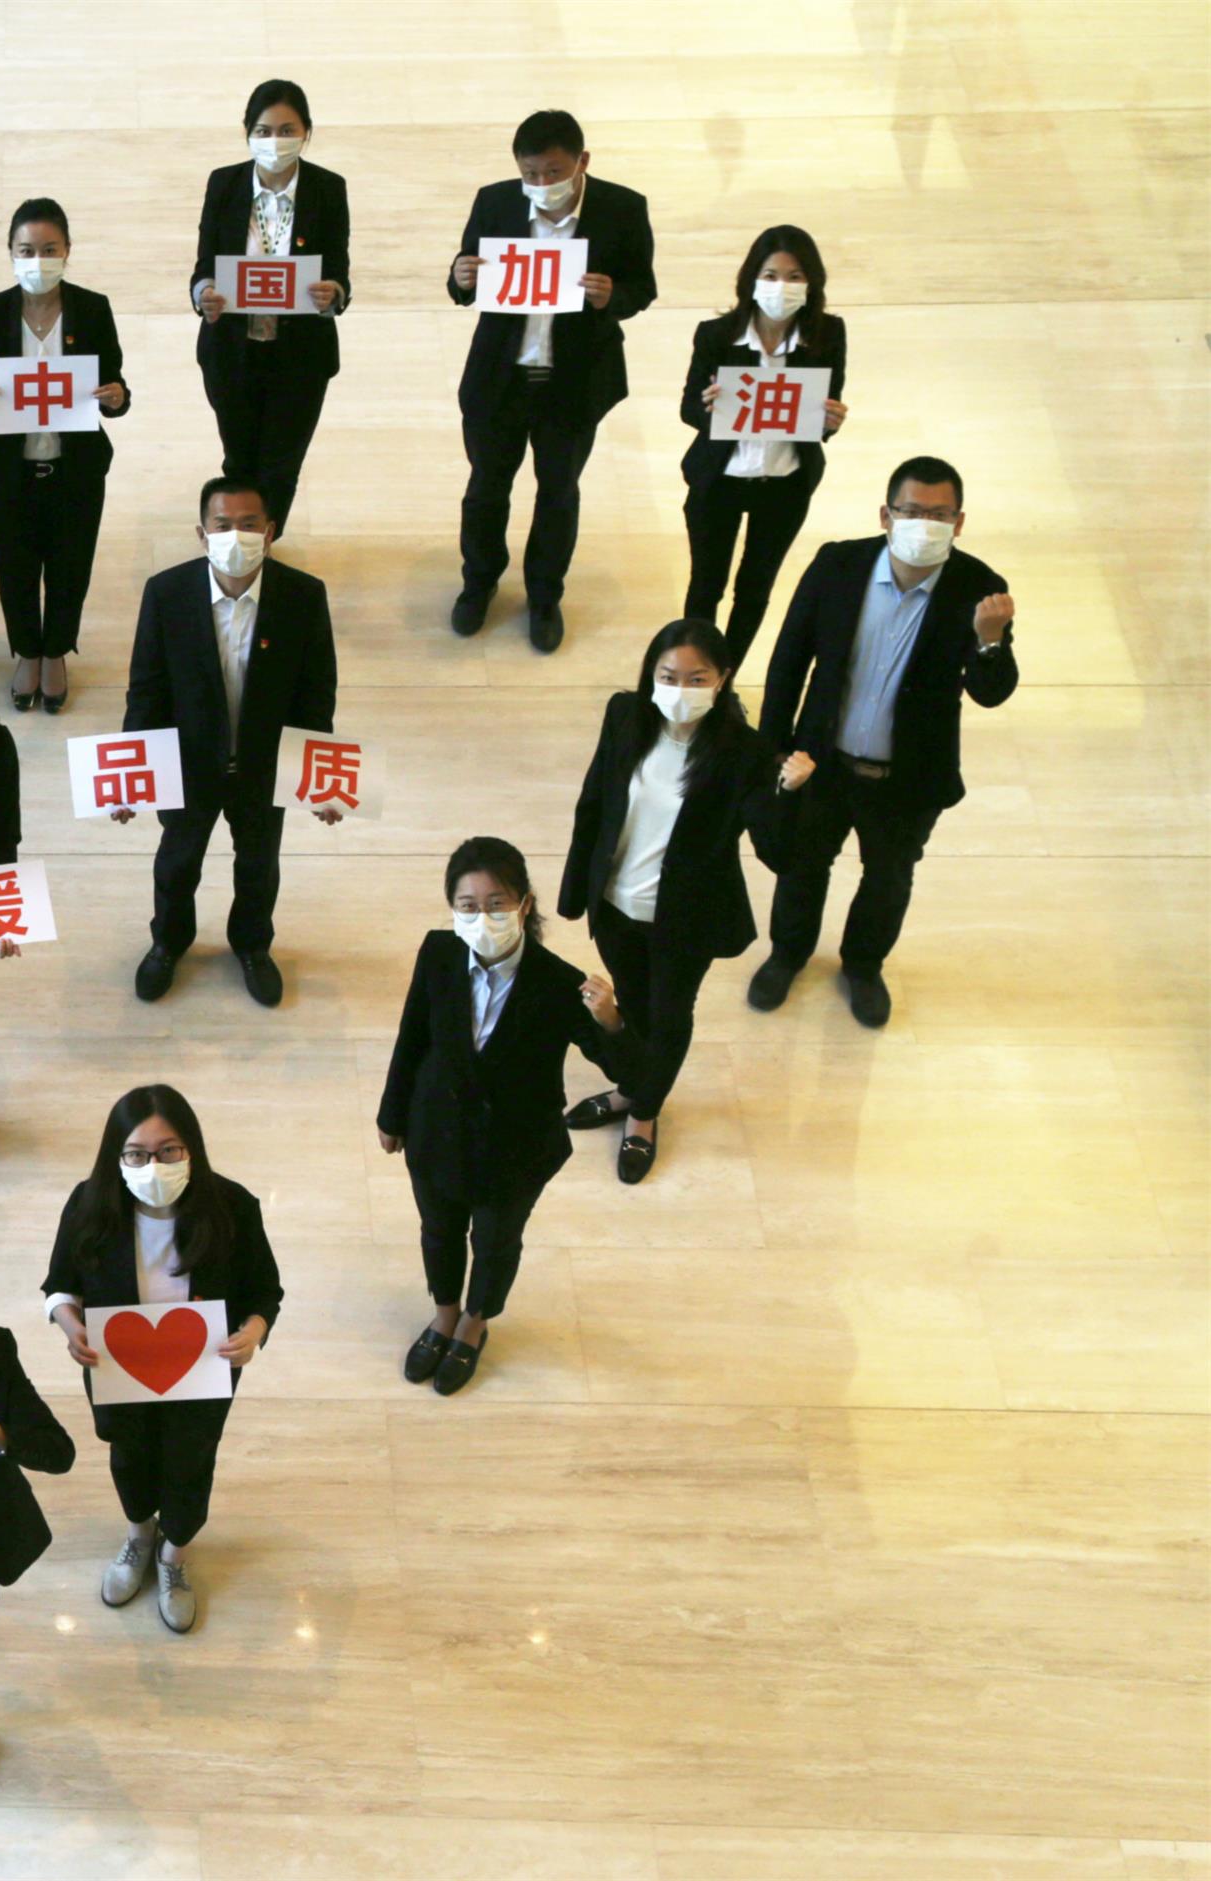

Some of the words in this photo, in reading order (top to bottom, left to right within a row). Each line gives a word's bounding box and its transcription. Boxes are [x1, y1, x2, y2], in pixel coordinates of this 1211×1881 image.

[236, 260, 297, 309] 国
[495, 242, 562, 308] 加
[13, 361, 74, 427] 中
[732, 372, 803, 435] 油
[93, 738, 157, 809] 品
[295, 738, 363, 810] 质
